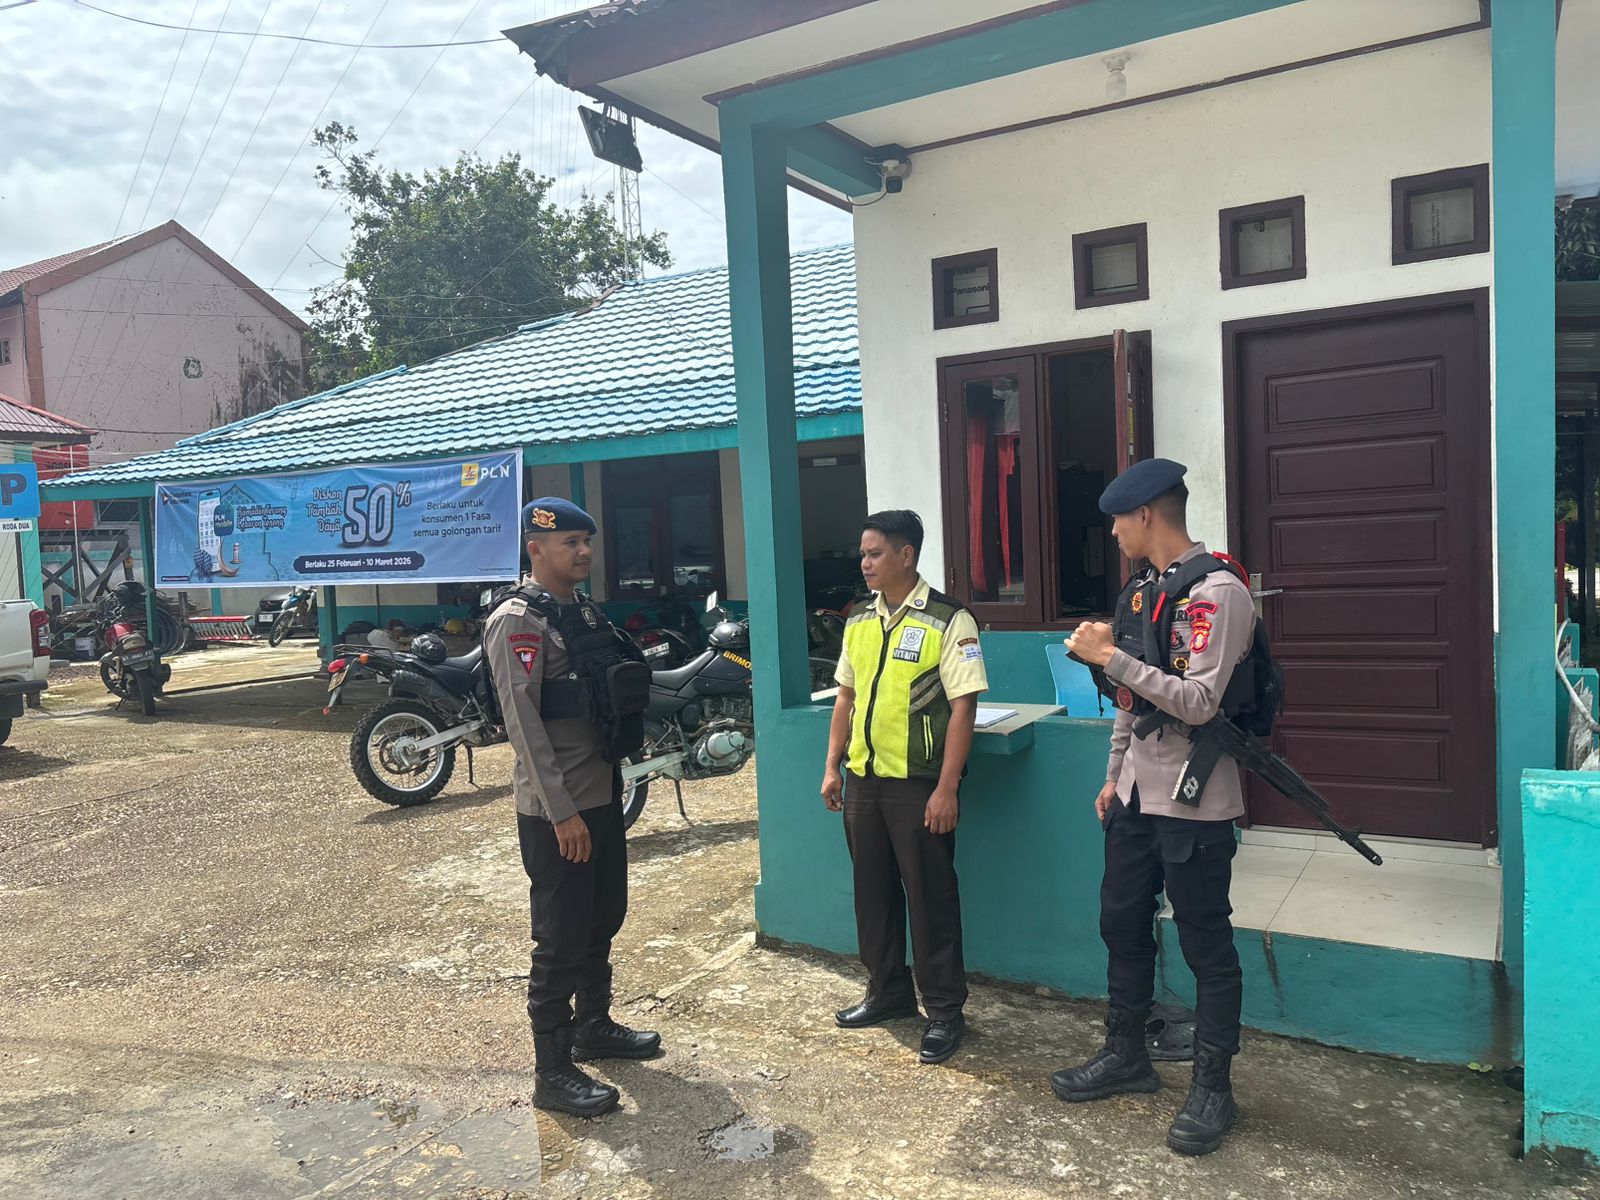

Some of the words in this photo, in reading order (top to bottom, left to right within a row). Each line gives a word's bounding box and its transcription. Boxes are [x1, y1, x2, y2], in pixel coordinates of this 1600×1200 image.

[953, 282, 990, 295] Panasoni
[480, 465, 510, 480] PLN
[0, 473, 27, 506] P
[313, 487, 343, 501] Diskon
[426, 501, 456, 510] Berlaku
[459, 498, 484, 508] untuk
[421, 513, 463, 524] konsumen
[465, 512, 469, 521] 1
[471, 512, 491, 521] Fasa
[413, 528, 439, 537] semua
[441, 526, 481, 538] golongan
[483, 524, 502, 534] tarif
[305, 560, 327, 569] Berlaku
[327, 559, 336, 568] 25
[336, 558, 362, 567] Februari
[366, 558, 374, 566] 10
[375, 557, 393, 566] Maret
[394, 556, 412, 565] 2026
[723, 650, 752, 670] BRIMO
